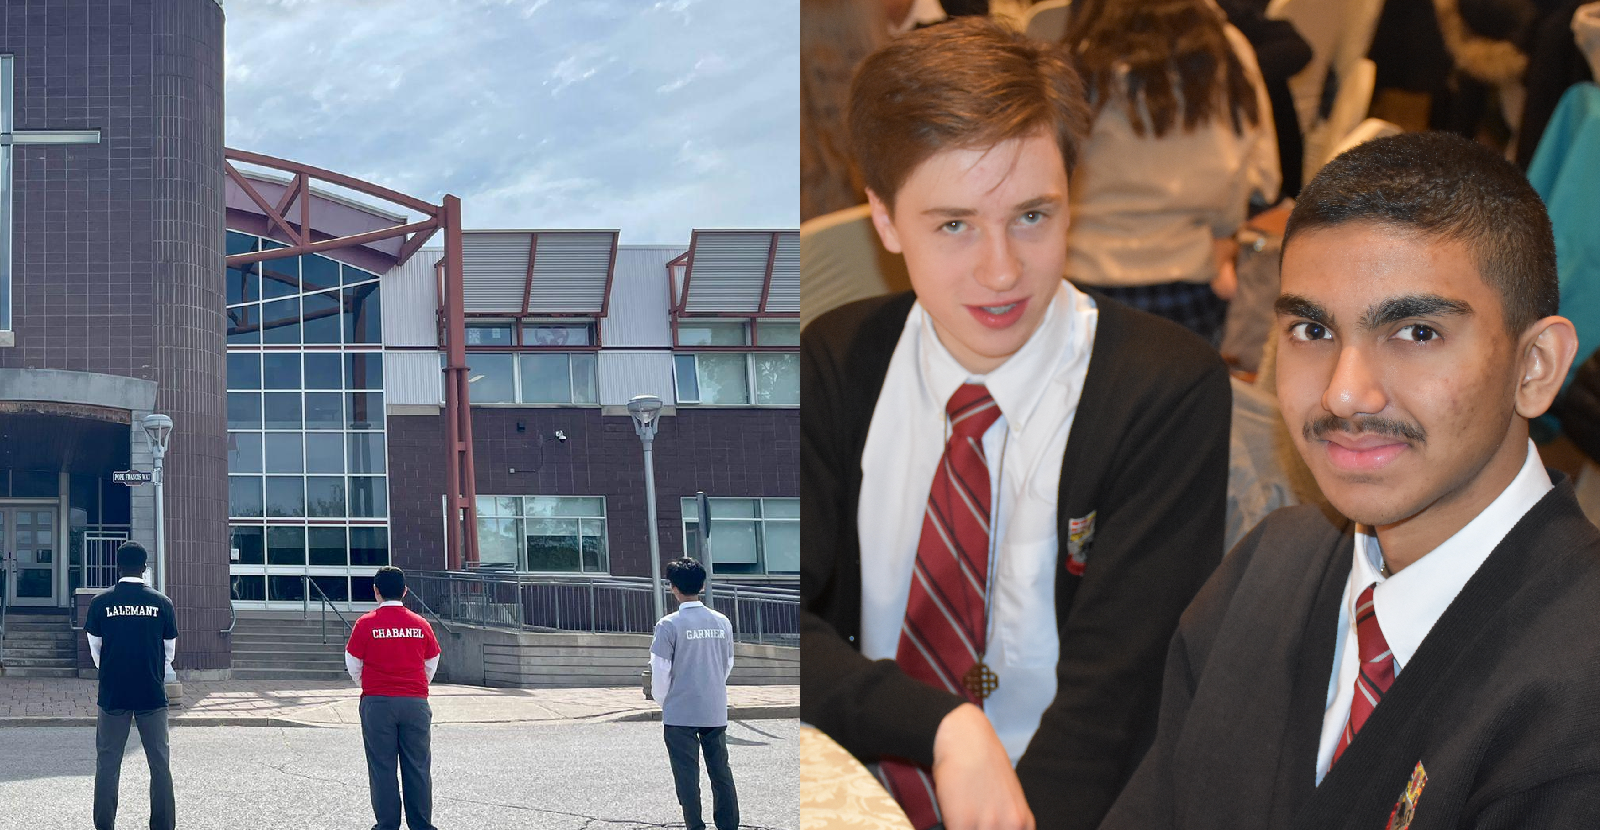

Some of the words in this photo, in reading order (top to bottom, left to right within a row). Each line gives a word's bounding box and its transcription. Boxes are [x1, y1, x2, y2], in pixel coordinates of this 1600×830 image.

[106, 605, 159, 617] LALEMANT
[372, 627, 424, 639] CHABANEL
[686, 629, 725, 640] GARNIER
